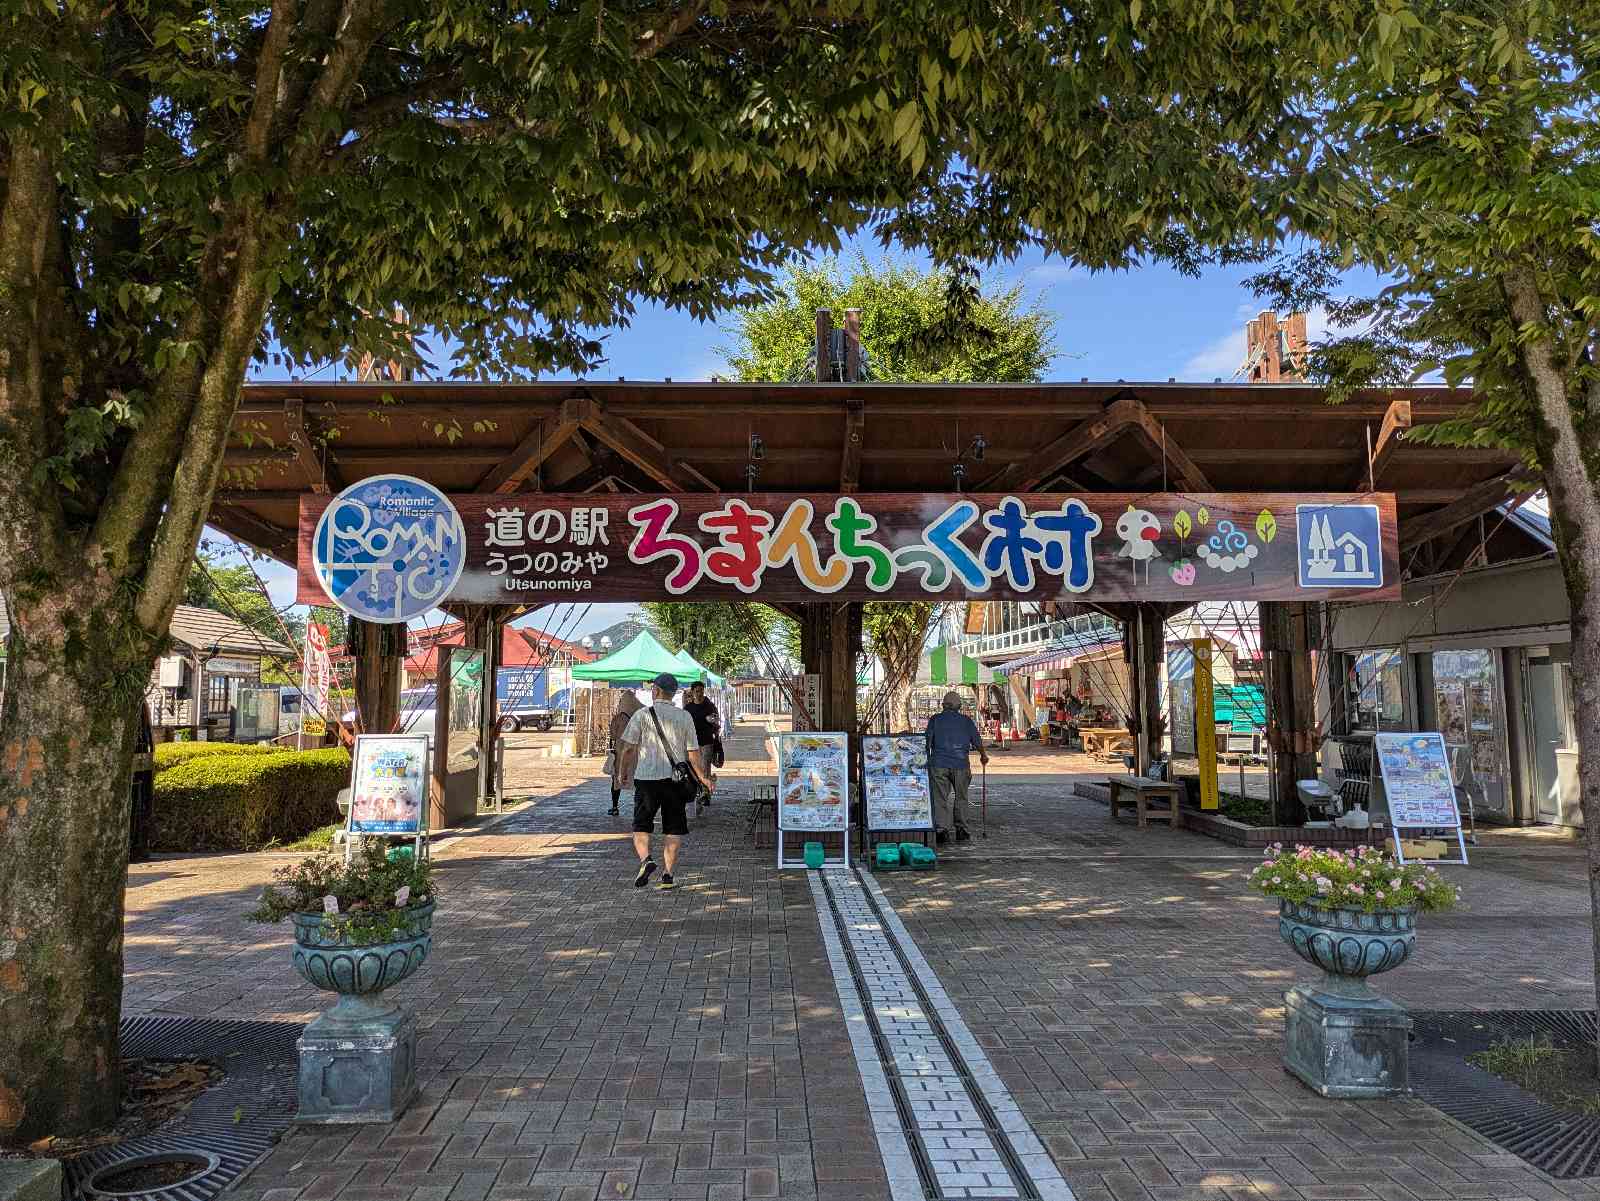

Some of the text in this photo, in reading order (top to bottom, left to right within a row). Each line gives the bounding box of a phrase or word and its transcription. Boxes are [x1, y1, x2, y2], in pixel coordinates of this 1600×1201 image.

[380, 495, 435, 506] Romantic
[393, 507, 433, 519] Village
[484, 506, 610, 546] 道の駅
[628, 496, 1102, 595] ろまんちっく村
[485, 551, 609, 576] うつのみや
[505, 577, 592, 592] Utsunomiya
